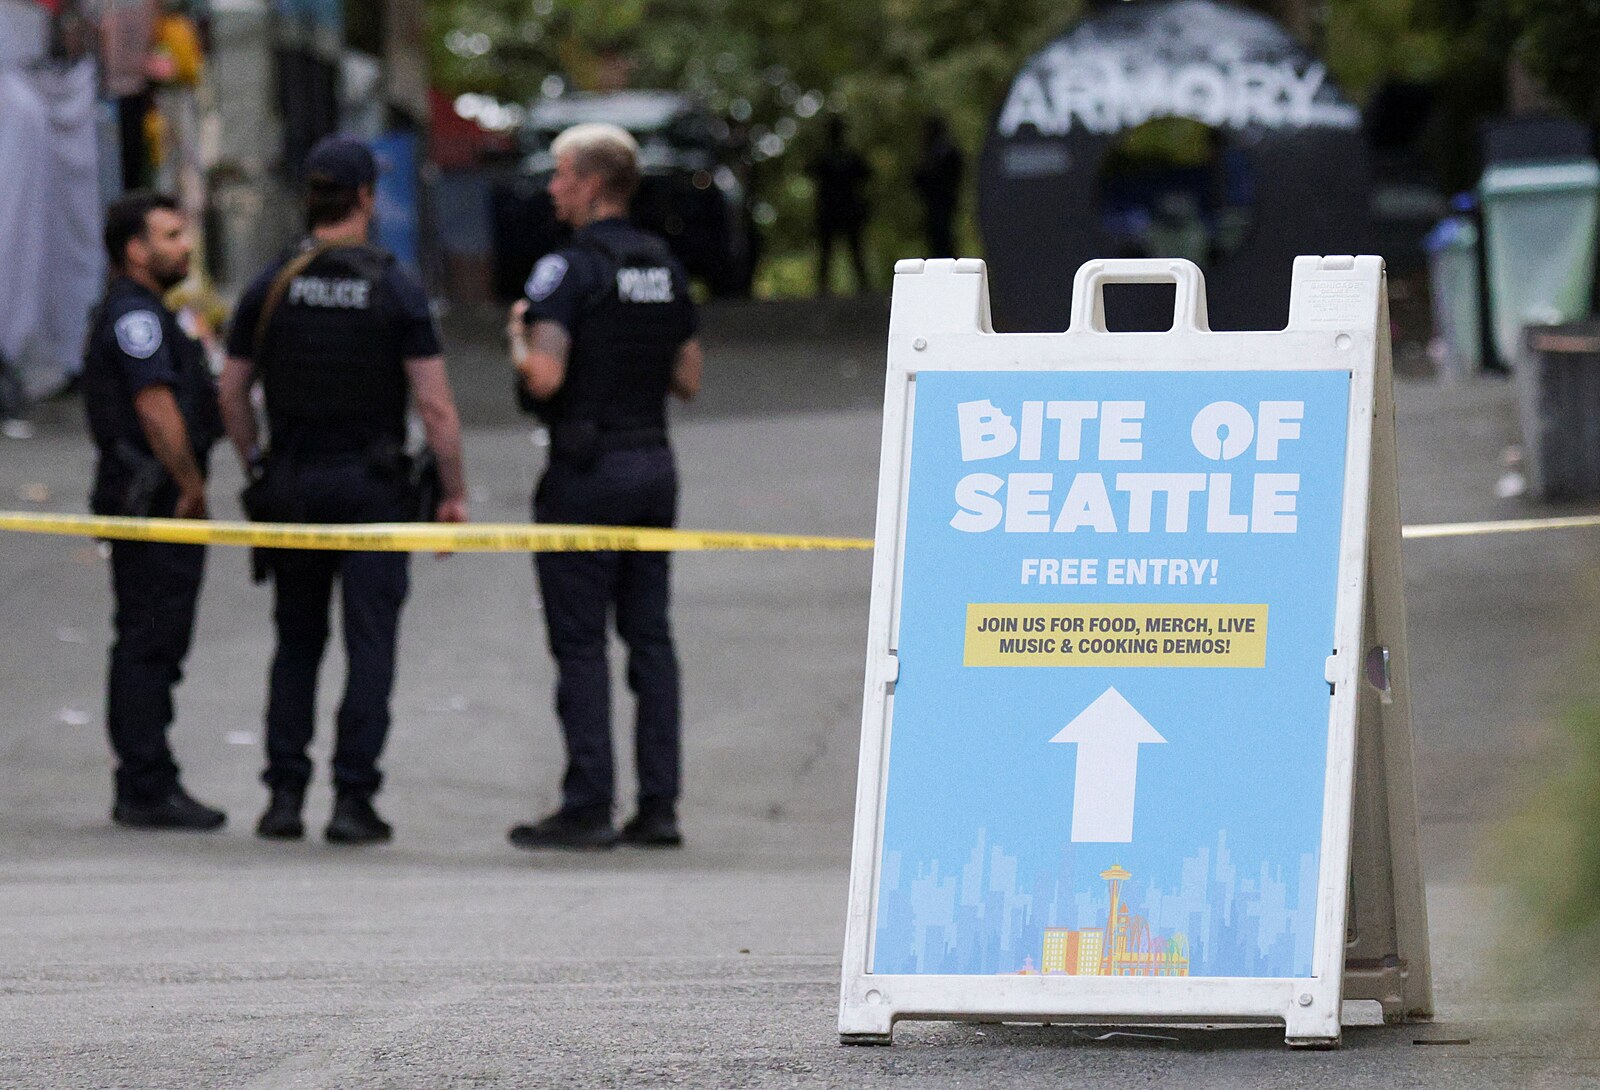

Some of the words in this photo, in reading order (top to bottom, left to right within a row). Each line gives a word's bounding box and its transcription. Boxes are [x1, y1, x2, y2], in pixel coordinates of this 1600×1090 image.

[999, 57, 1345, 137] ARMORY
[288, 277, 369, 309] POLICE
[617, 267, 673, 303] POLICE
[957, 399, 1146, 462] BITE
[1190, 400, 1305, 461] OF
[949, 472, 1301, 533] SEATTLE
[1020, 558, 1099, 585] FREE
[1106, 558, 1219, 585] ENTRY!
[977, 617, 1018, 633] JOIN
[1022, 617, 1046, 633] US
[1050, 617, 1085, 633] FOR
[1089, 617, 1141, 636] FOOD,
[1145, 617, 1213, 636] MERCH,
[1217, 618, 1256, 633] LIVE
[999, 638, 1056, 654] MUSIC
[1060, 638, 1074, 654] &
[1078, 638, 1158, 654] COOKING
[1162, 638, 1231, 654] DEMOS!
